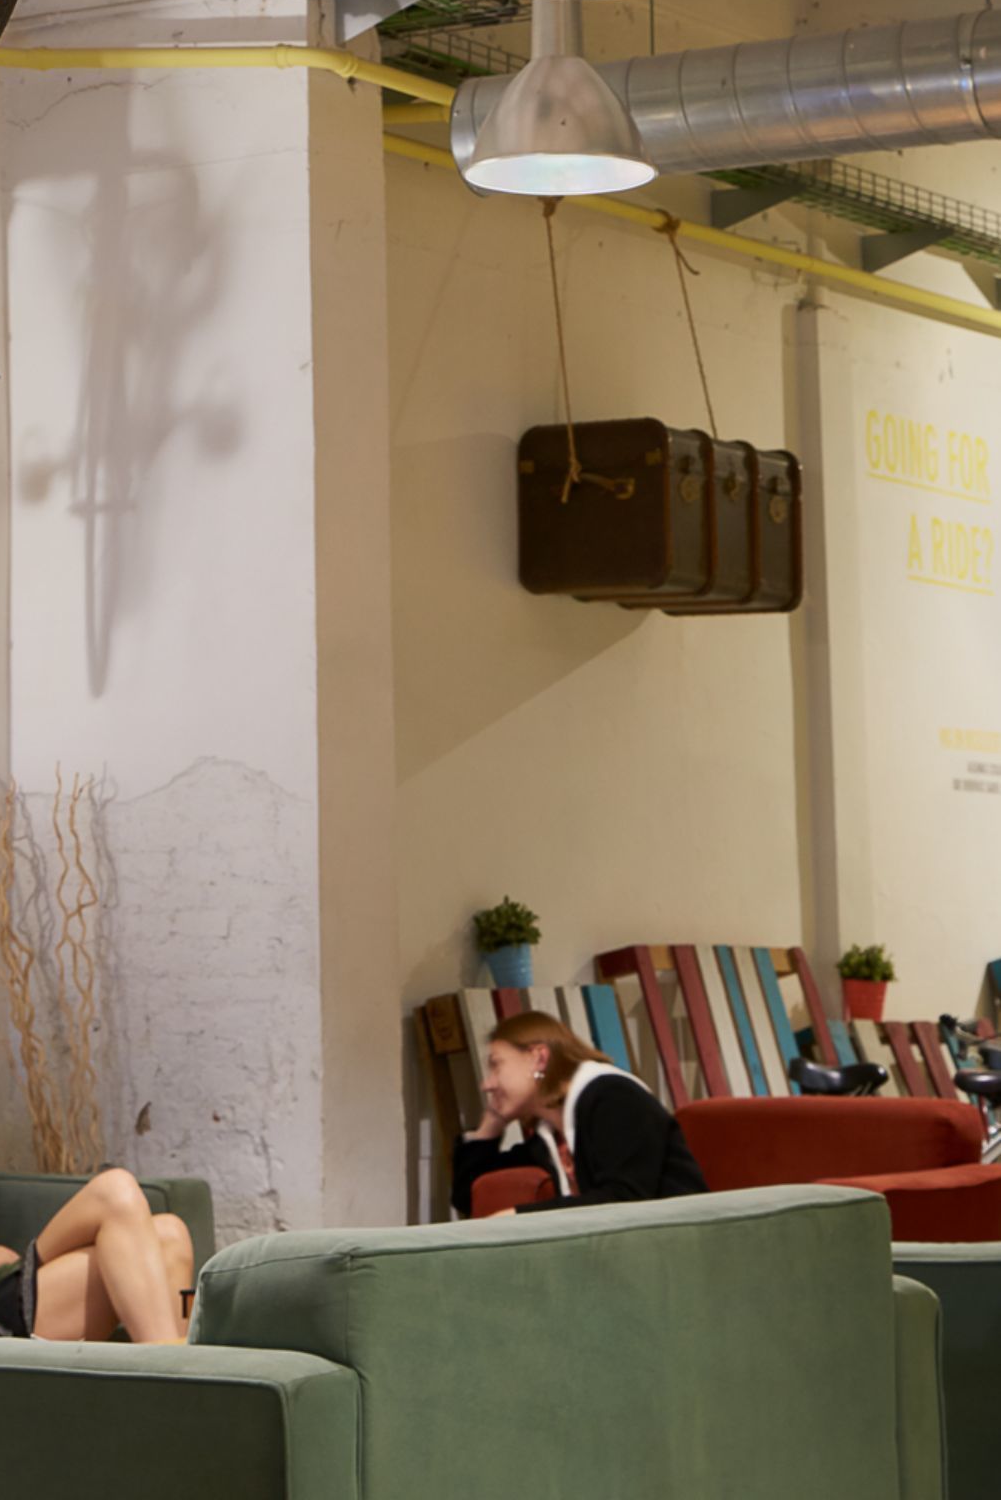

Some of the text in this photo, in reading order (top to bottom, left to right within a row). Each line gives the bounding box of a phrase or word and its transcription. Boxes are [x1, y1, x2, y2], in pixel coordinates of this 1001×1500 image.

[865, 409, 992, 496] GOING FOR
[906, 511, 995, 585] A RIDE?
